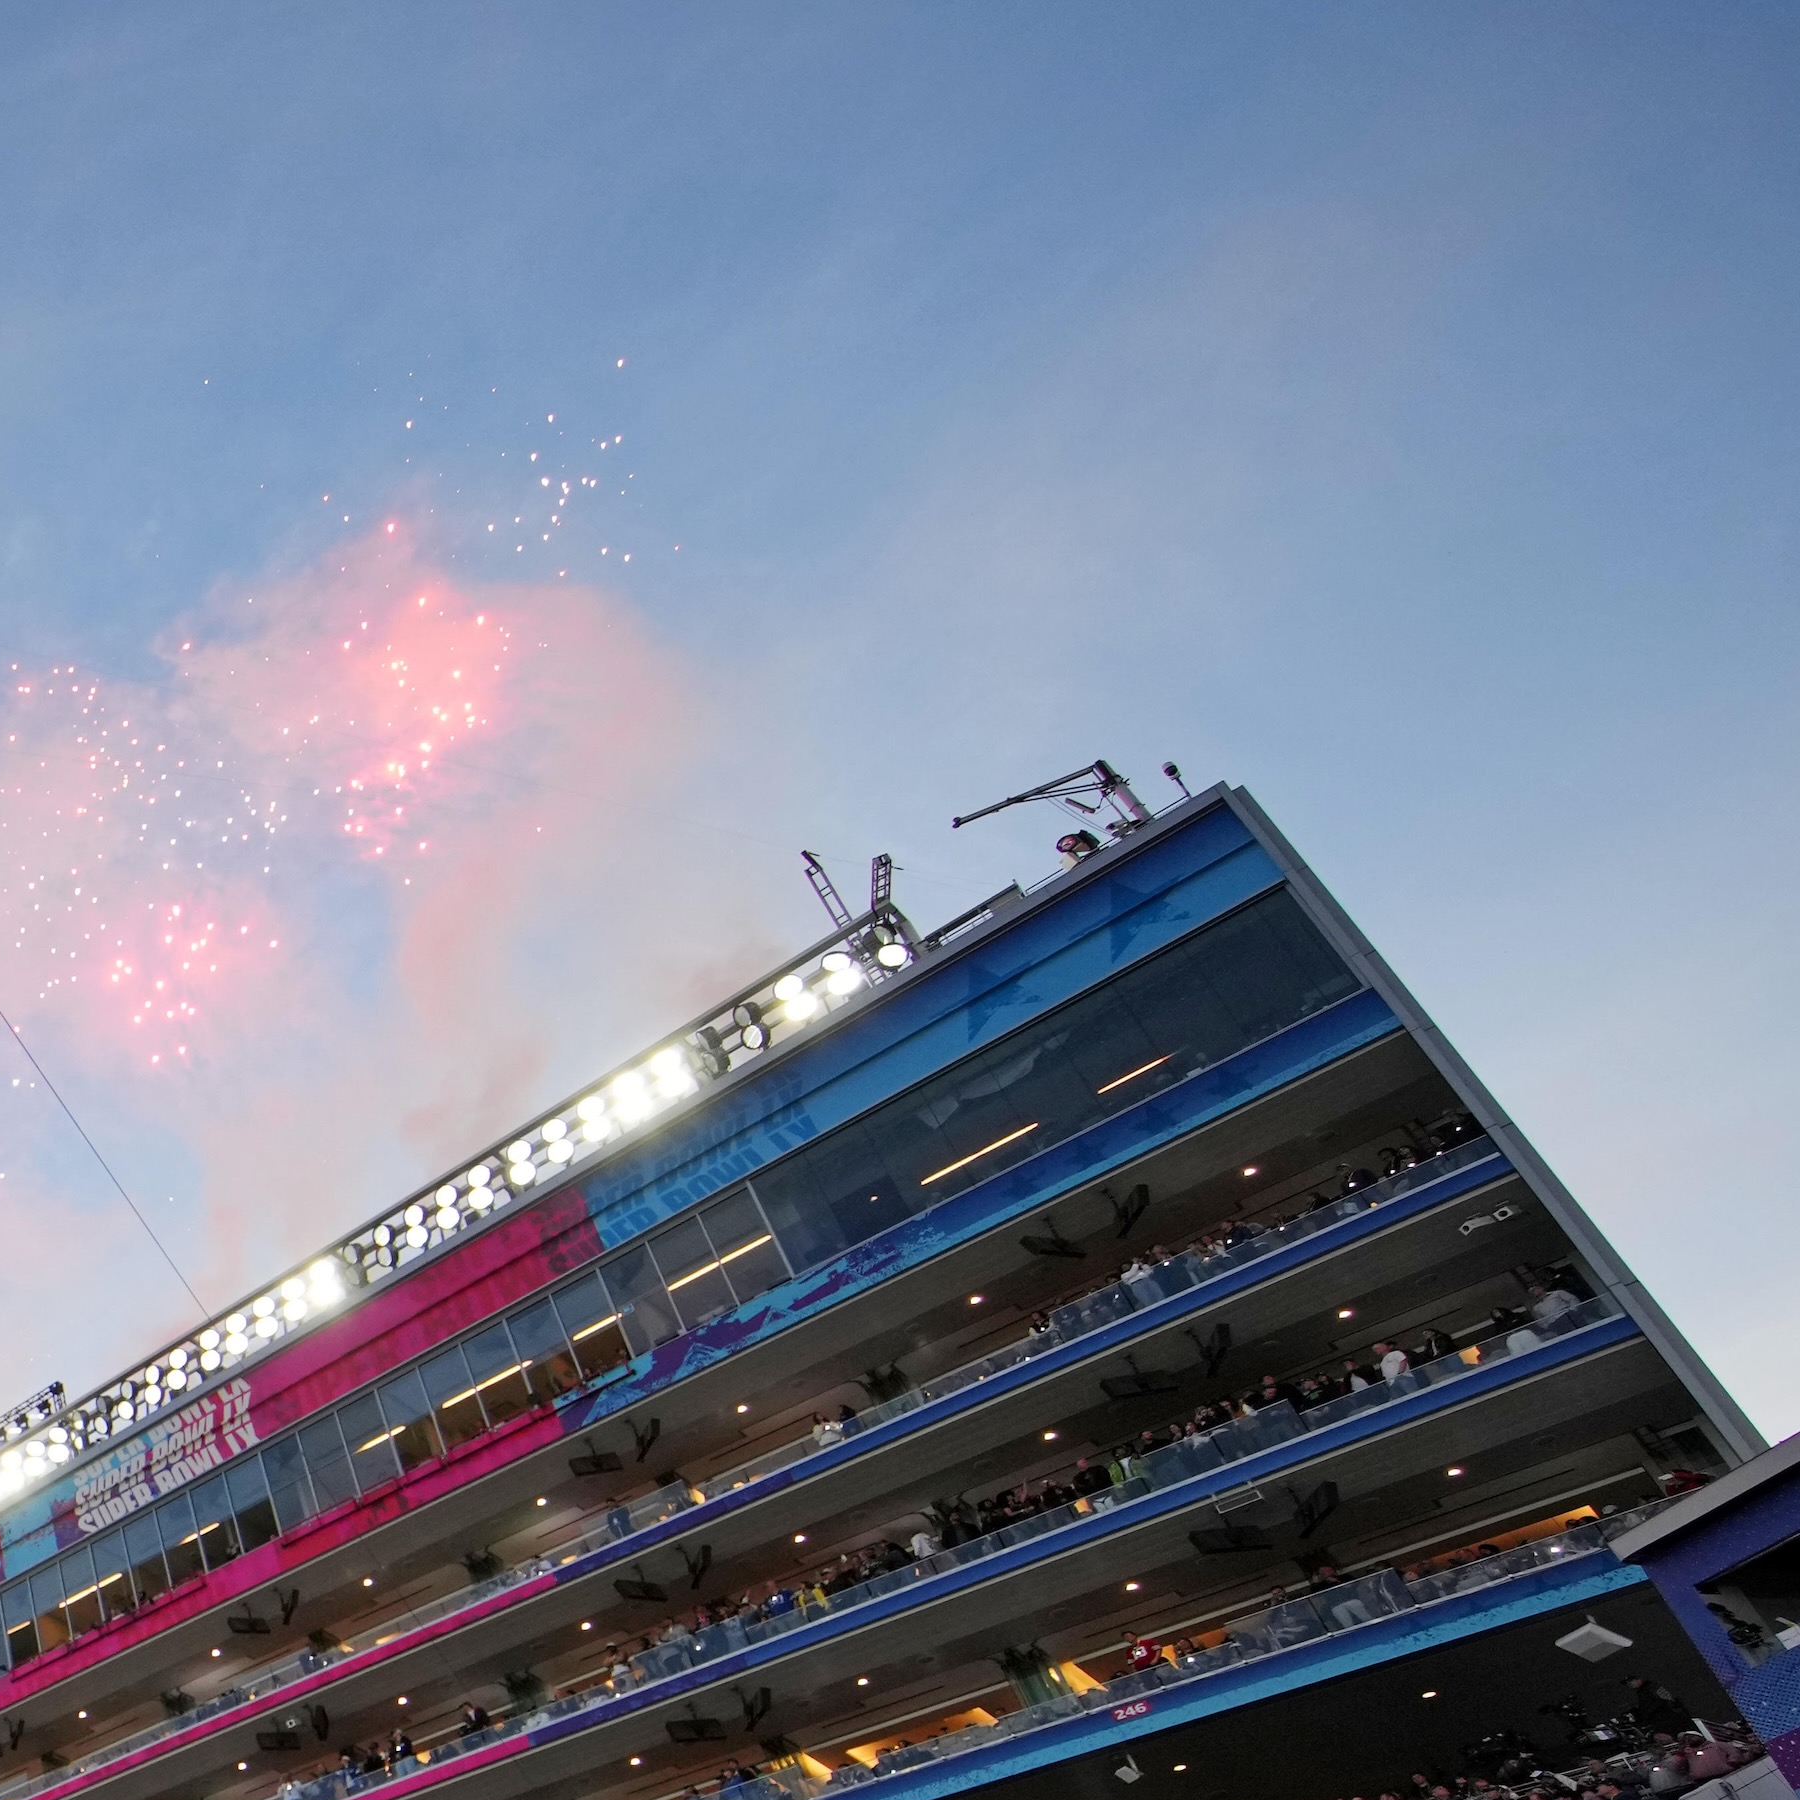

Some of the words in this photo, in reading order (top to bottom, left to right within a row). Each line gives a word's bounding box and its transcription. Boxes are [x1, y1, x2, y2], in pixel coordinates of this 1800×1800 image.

[75, 1452, 147, 1517] SUPER
[146, 1412, 216, 1473] BOWL
[1113, 1701, 1148, 1721] 246
